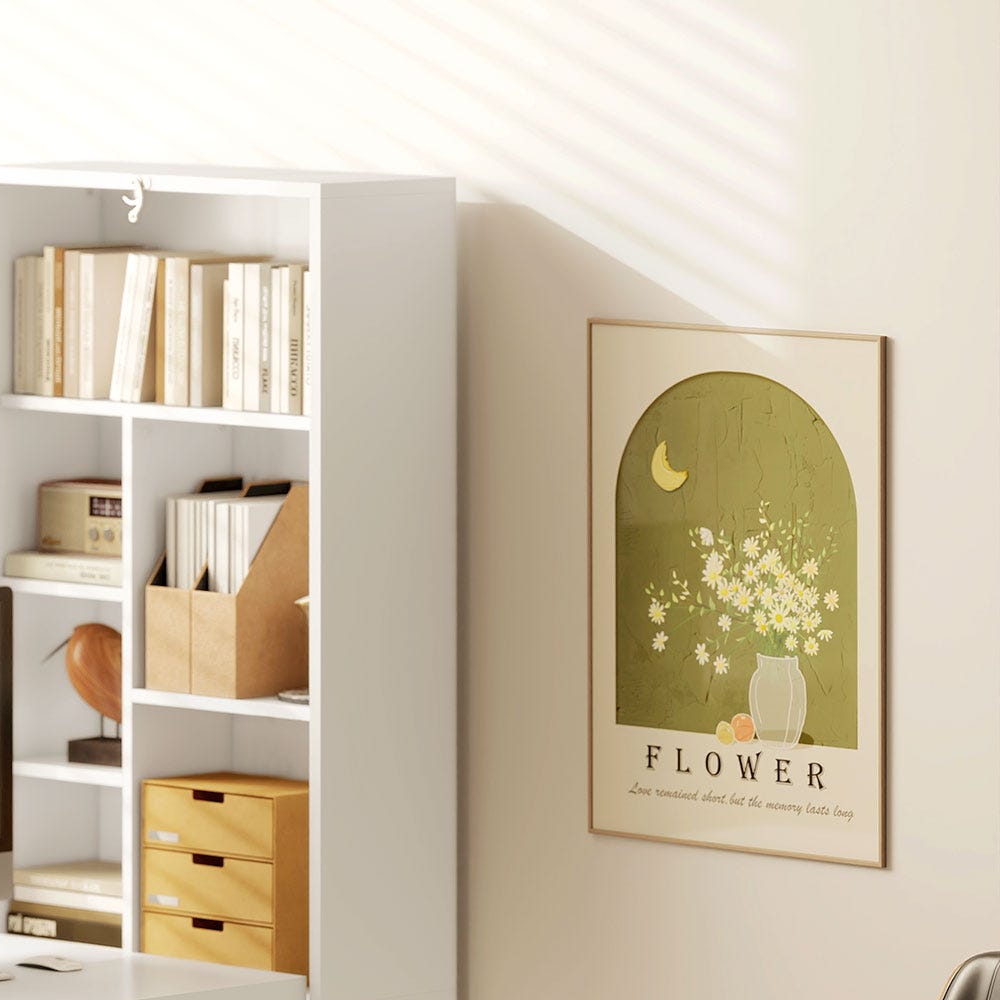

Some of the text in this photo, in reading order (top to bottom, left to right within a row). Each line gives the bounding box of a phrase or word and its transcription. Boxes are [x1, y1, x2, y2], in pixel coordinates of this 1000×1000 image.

[645, 745, 825, 790] FLOWER
[628, 782, 652, 796] Love
[655, 789, 699, 801] remained
[748, 795, 762, 808] the
[766, 801, 802, 816] memory
[805, 802, 829, 816] lasts
[834, 805, 854, 822] long
